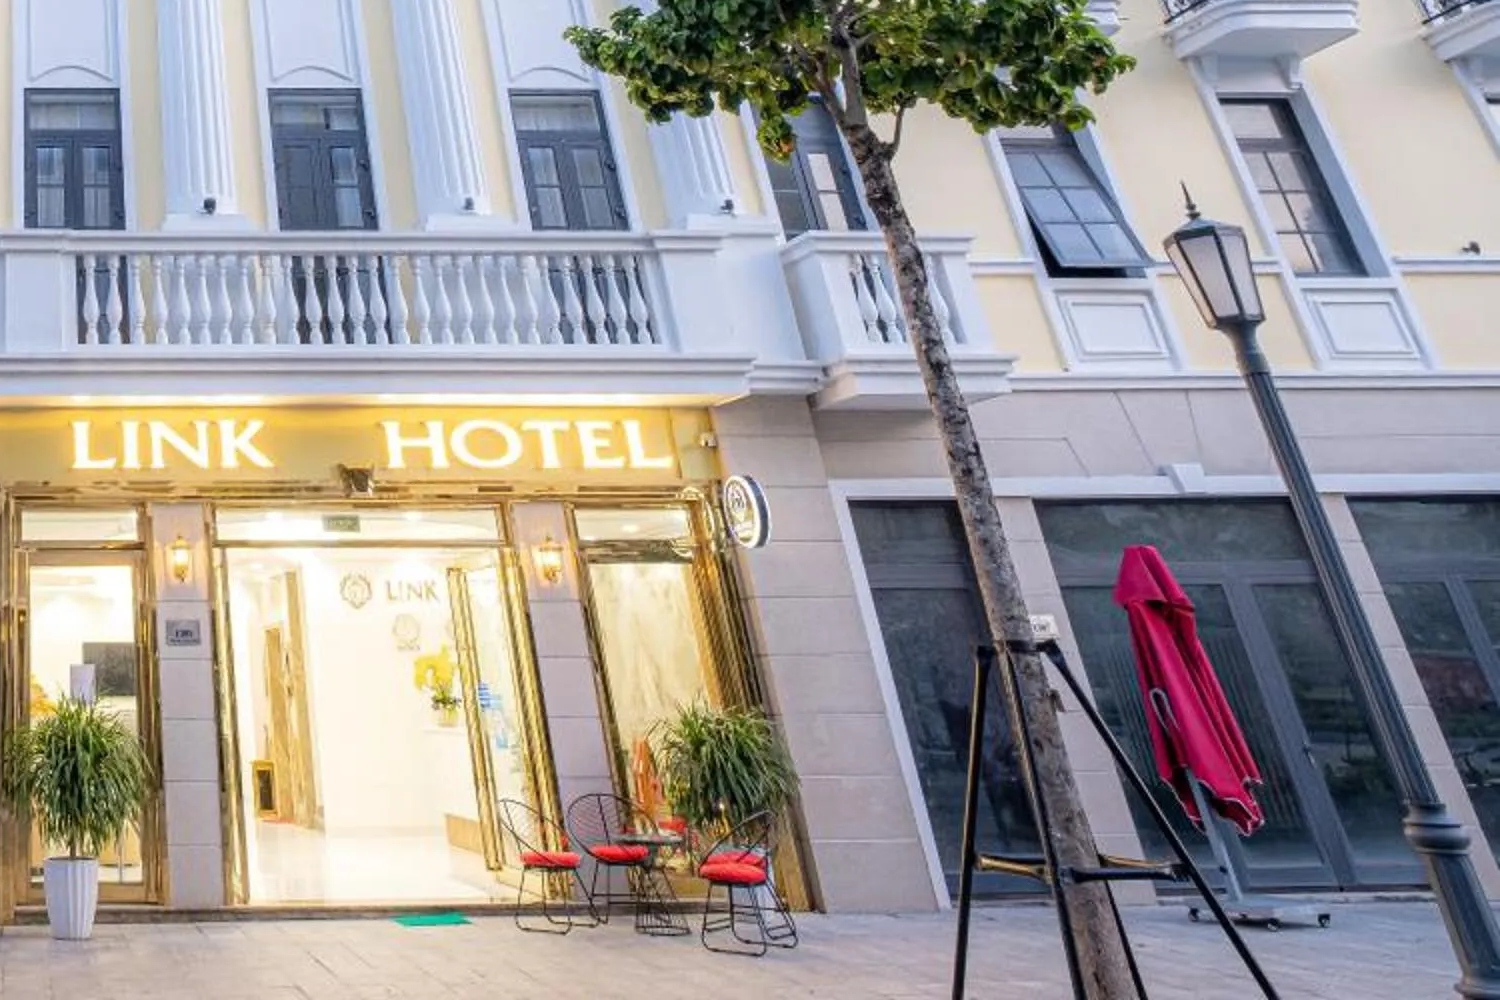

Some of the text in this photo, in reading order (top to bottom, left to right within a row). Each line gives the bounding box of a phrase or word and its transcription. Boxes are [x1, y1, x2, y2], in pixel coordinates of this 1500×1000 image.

[71, 418, 674, 470] LINK HOTEL
[386, 579, 440, 602] LINK
